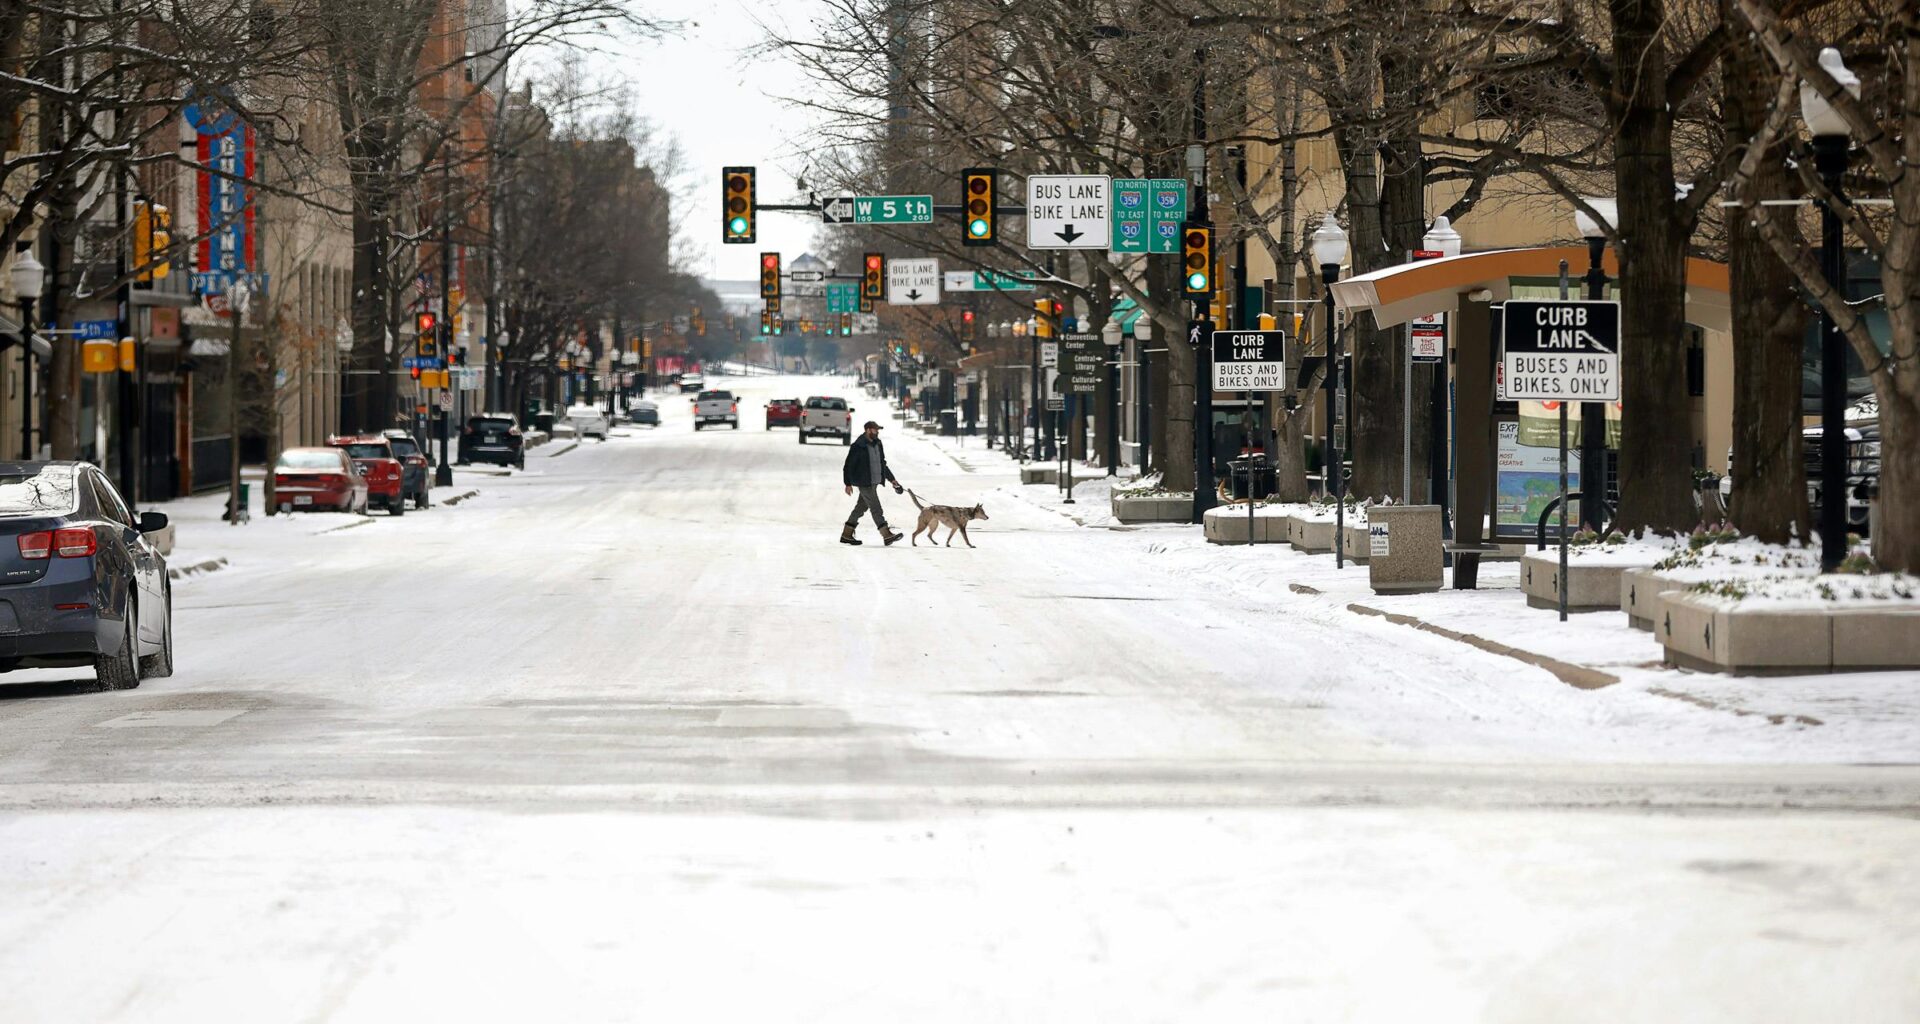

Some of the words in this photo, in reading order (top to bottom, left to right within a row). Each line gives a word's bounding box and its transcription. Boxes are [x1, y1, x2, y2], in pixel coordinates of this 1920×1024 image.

[1126, 181, 1147, 189] NORTH
[1162, 181, 1184, 189] SOUTH
[1036, 185, 1062, 199] BUS
[1069, 184, 1102, 199] LANE
[1123, 196, 1137, 206] 35W
[1160, 196, 1175, 206] 35W
[858, 201, 872, 215] W
[1034, 205, 1063, 219] BIKE
[1071, 205, 1105, 219] LANE
[1128, 210, 1145, 218] EAST
[1164, 210, 1183, 218] WEST
[1124, 226, 1137, 235] 30
[1162, 226, 1174, 235] 30
[892, 265, 909, 274] BUS
[913, 264, 933, 273] LANE
[892, 278, 910, 287] BIKE
[914, 277, 935, 286] LANE
[1536, 307, 1588, 326] CURB
[1232, 335, 1265, 346] CURB
[1537, 329, 1586, 349] LANE
[1233, 348, 1264, 360] LANE
[1075, 363, 1096, 371] Library
[1220, 365, 1253, 375] BUSES
[1257, 364, 1277, 375] AND
[1515, 357, 1568, 374] BUSES
[1576, 358, 1608, 374] AND
[1219, 377, 1249, 387] BIKES
[1253, 376, 1278, 387] ONLY
[1514, 377, 1561, 392] BIKES
[1570, 377, 1609, 394] ONLY
[1499, 423, 1518, 433] EXP
